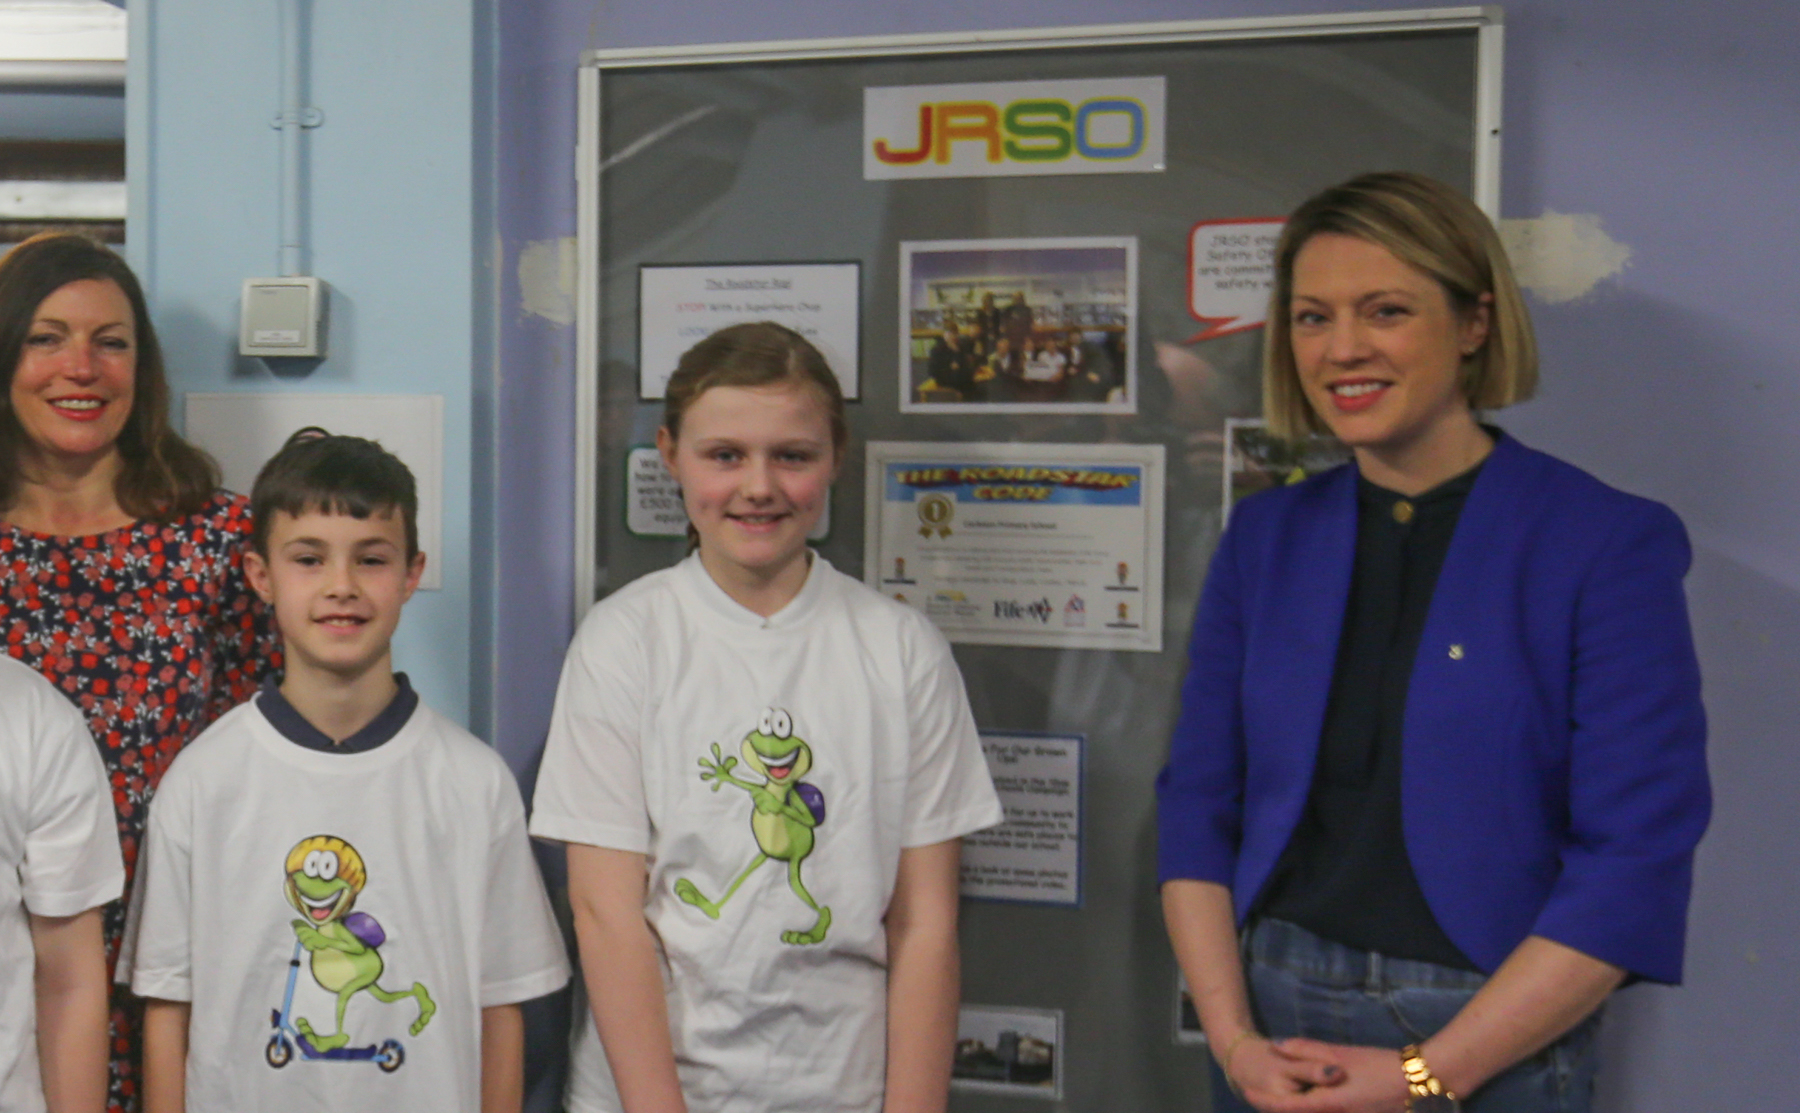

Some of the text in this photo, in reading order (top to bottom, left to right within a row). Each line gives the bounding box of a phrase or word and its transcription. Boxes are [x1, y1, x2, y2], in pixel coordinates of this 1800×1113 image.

[873, 97, 1147, 165] JRSO
[896, 469, 956, 484] THE
[972, 485, 1053, 500] CODE
[993, 600, 1023, 618] Fife
